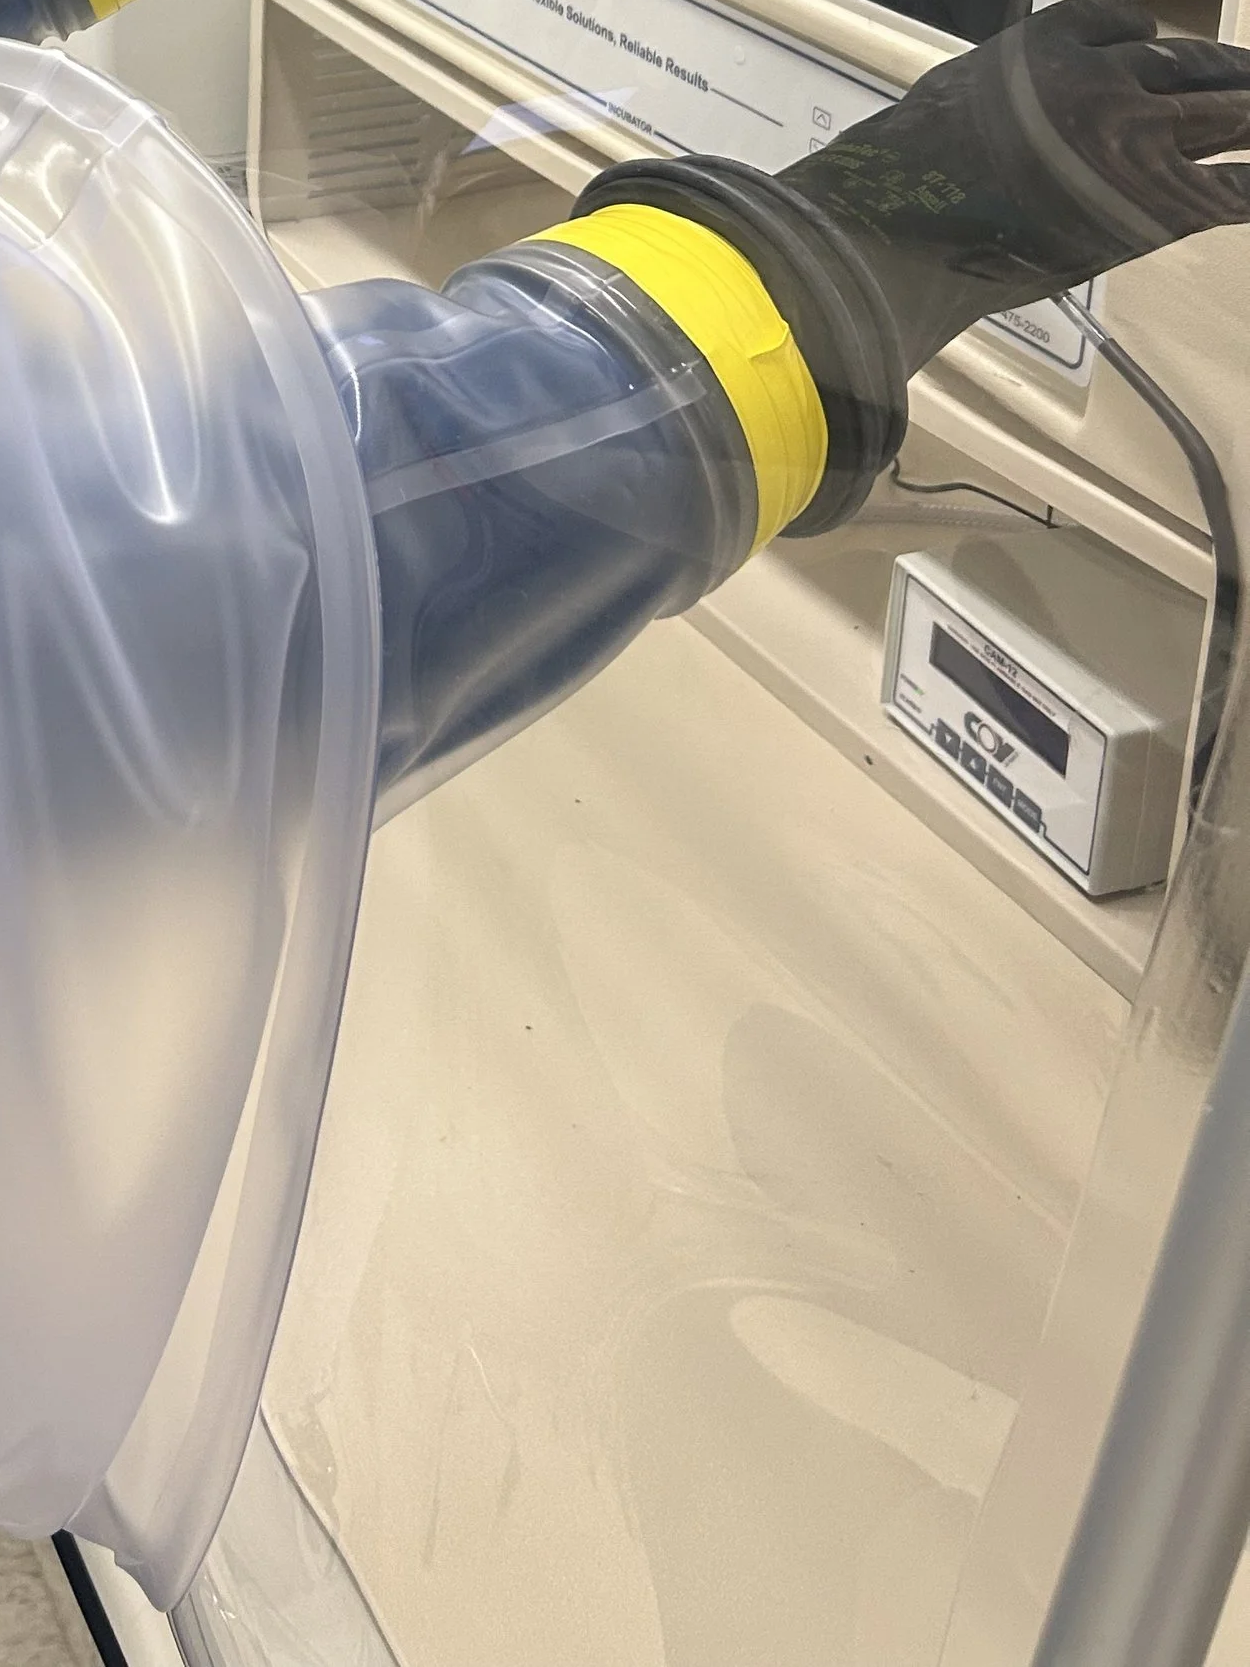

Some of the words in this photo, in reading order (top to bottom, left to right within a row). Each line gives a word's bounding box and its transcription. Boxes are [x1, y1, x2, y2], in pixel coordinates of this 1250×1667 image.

[565, 3, 618, 47] Solutions,
[619, 32, 663, 69] Reliable
[664, 56, 710, 93] Results
[607, 101, 653, 136] INCUBATOR
[964, 711, 1016, 764] COY
